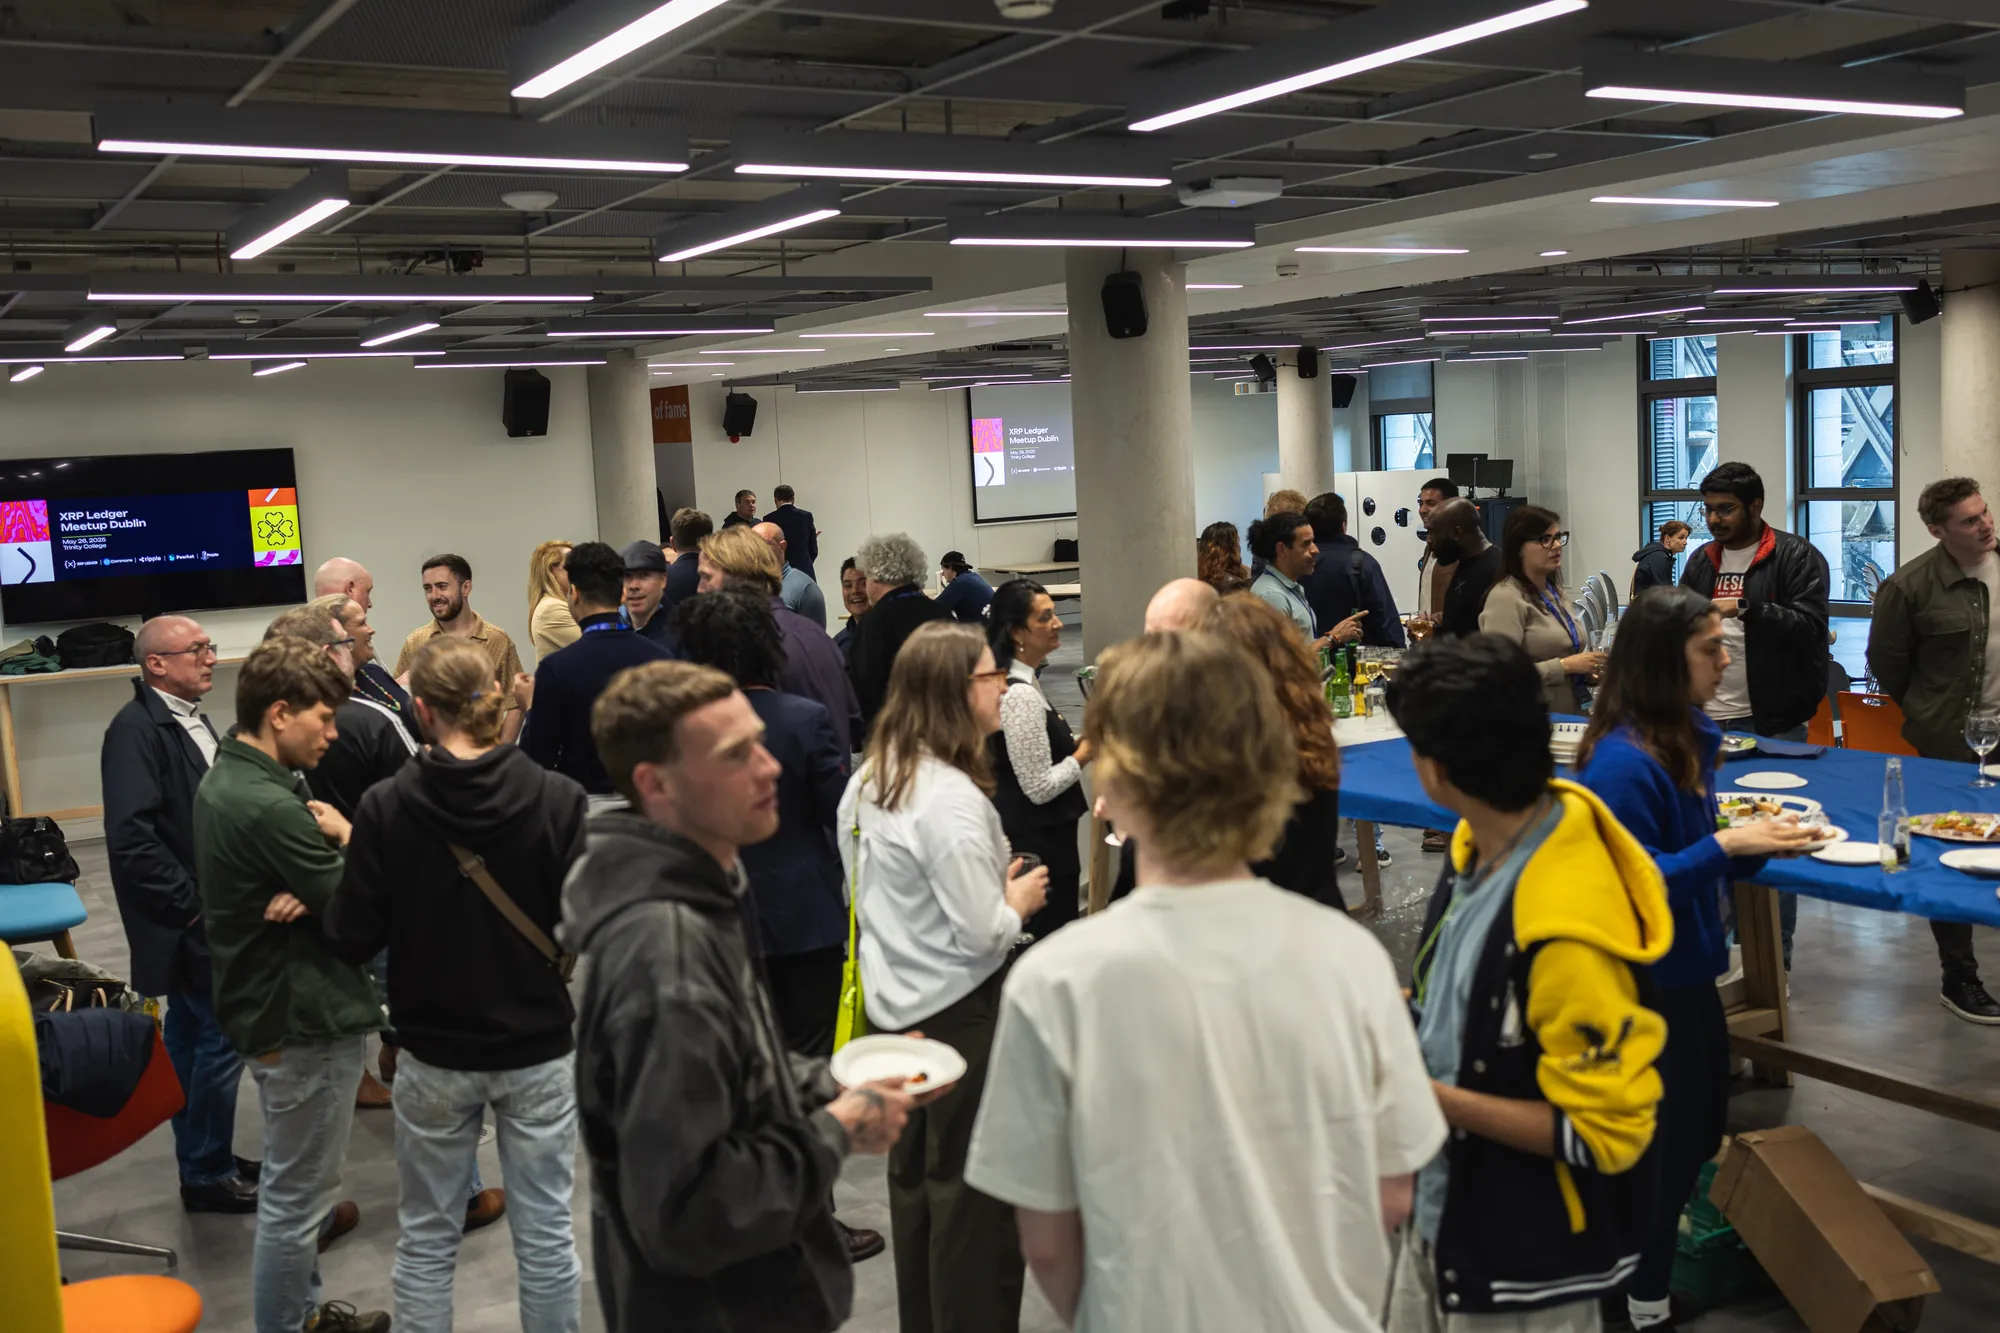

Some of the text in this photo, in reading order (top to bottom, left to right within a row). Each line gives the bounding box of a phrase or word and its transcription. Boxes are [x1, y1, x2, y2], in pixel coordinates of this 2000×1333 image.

[654, 400, 687, 420] of fame
[1024, 427, 1048, 435] Ledger
[59, 509, 129, 522] XRP Ledger
[60, 518, 147, 532] Meetup Dublin
[62, 538, 77, 546] May
[62, 542, 107, 551] Trinity College
[144, 555, 162, 563] ripple
